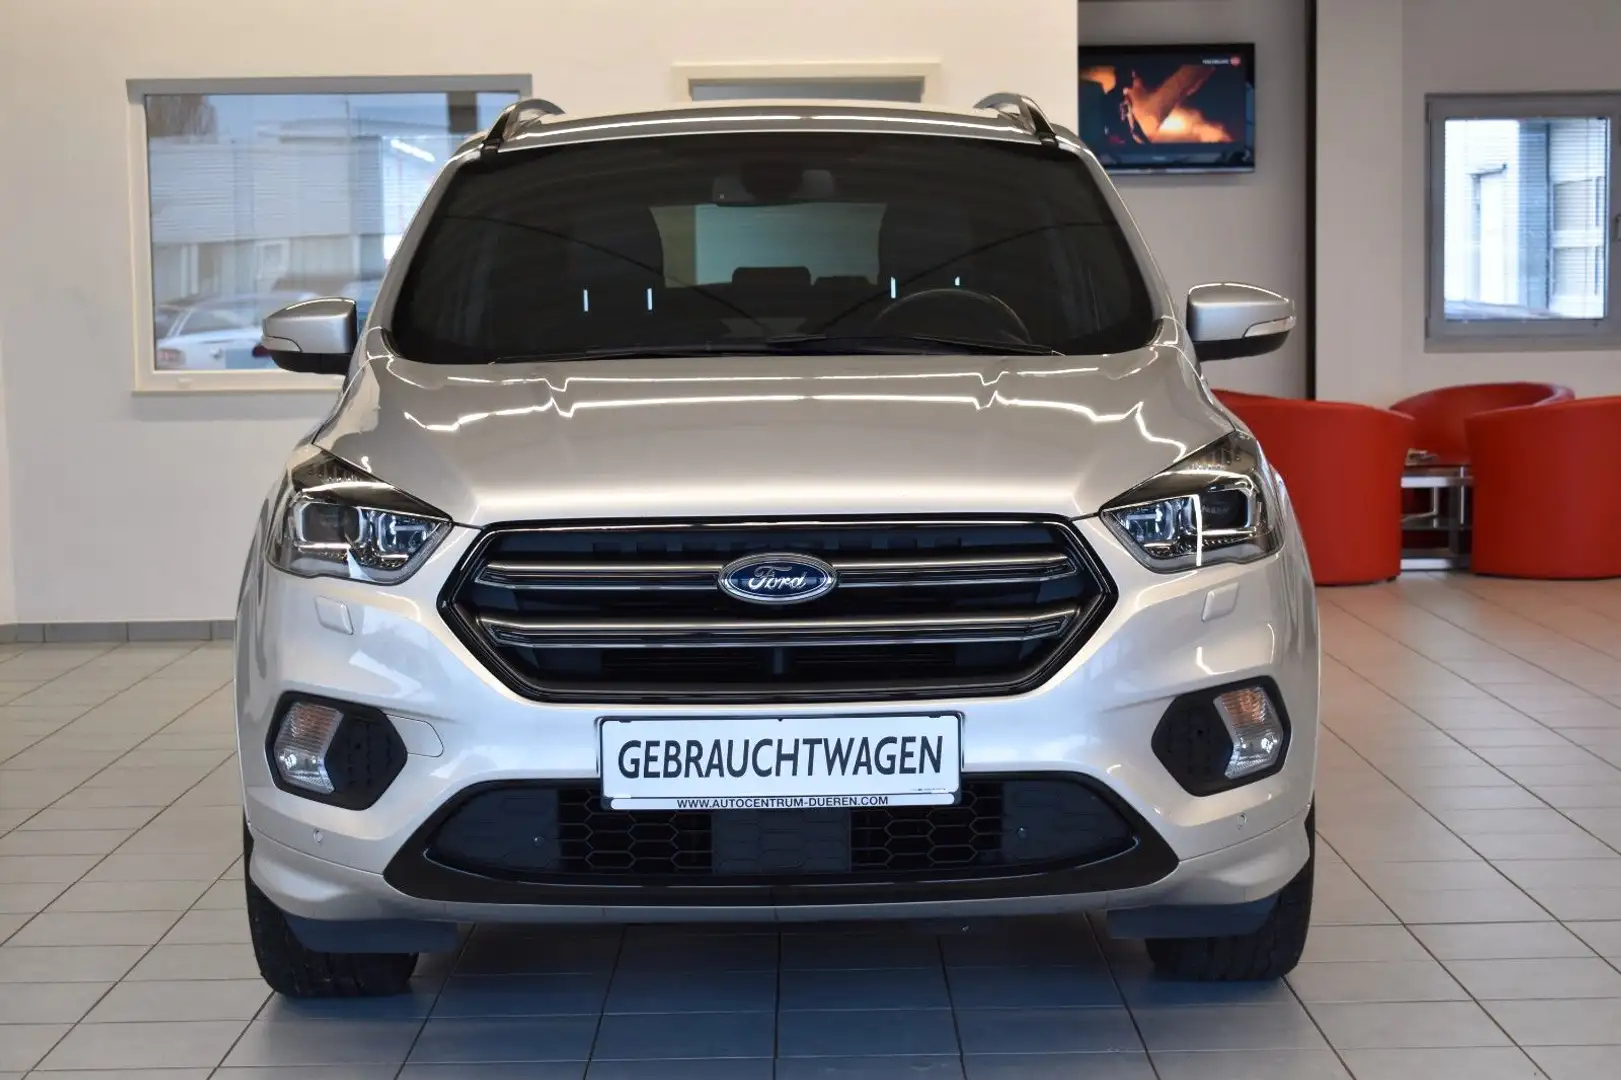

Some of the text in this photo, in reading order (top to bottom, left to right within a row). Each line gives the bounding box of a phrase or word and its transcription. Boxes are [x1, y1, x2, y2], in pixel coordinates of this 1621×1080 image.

[748, 565, 808, 591] Ford
[618, 735, 944, 779] GEBRAUCHTWAGEN
[676, 795, 889, 810] WWW.AUTOCENTRUM-DUEREN.COM
